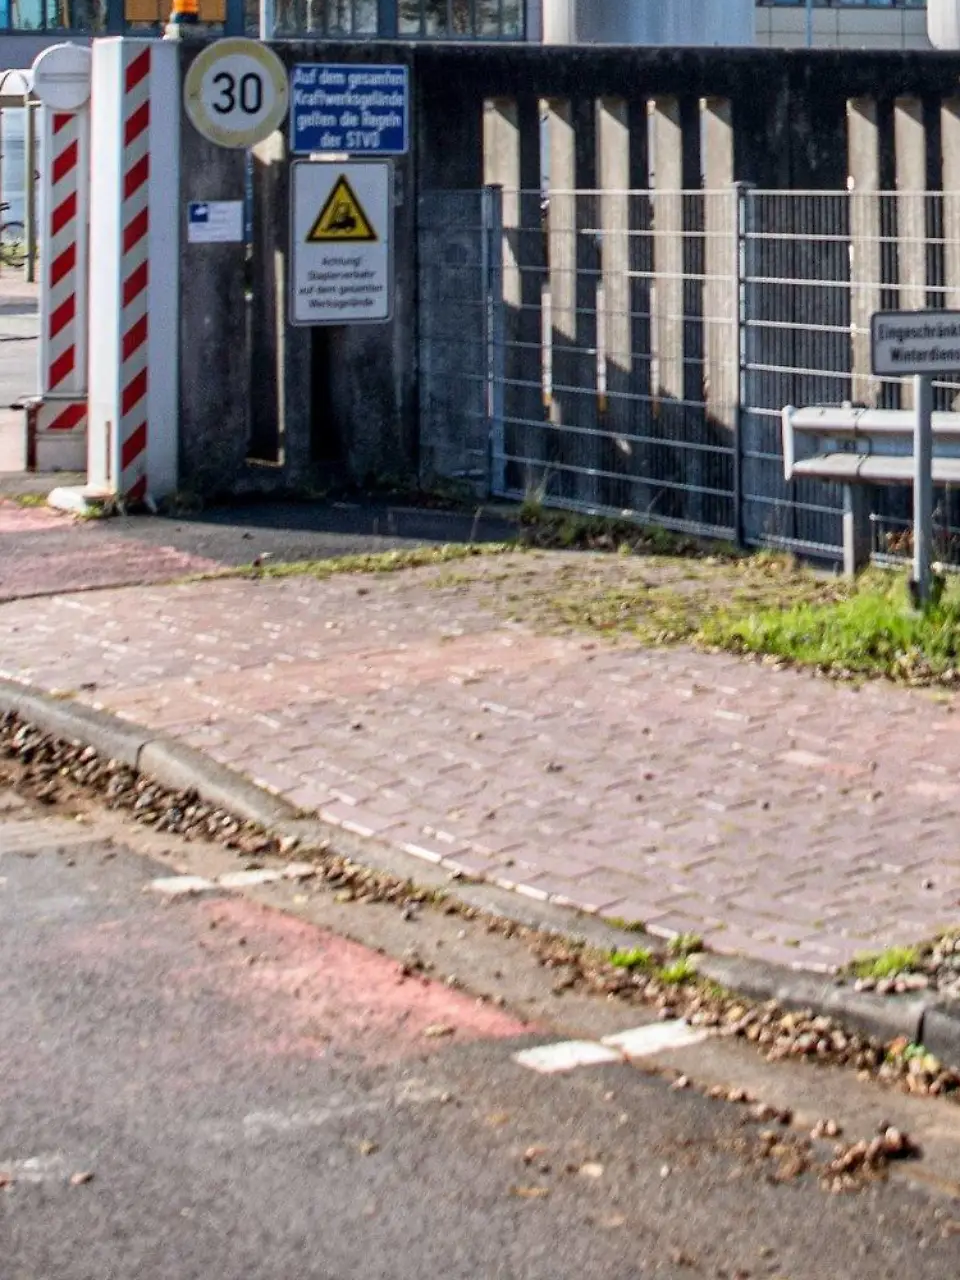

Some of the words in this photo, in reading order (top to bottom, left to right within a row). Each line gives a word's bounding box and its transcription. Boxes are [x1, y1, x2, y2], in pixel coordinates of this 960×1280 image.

[294, 68, 317, 84] Auf
[319, 69, 346, 85] dem
[347, 70, 403, 89] gesamten
[212, 72, 263, 115] 30
[297, 110, 337, 131] gelten
[339, 111, 360, 127] die
[361, 110, 402, 131] Regeln
[320, 131, 342, 148] der
